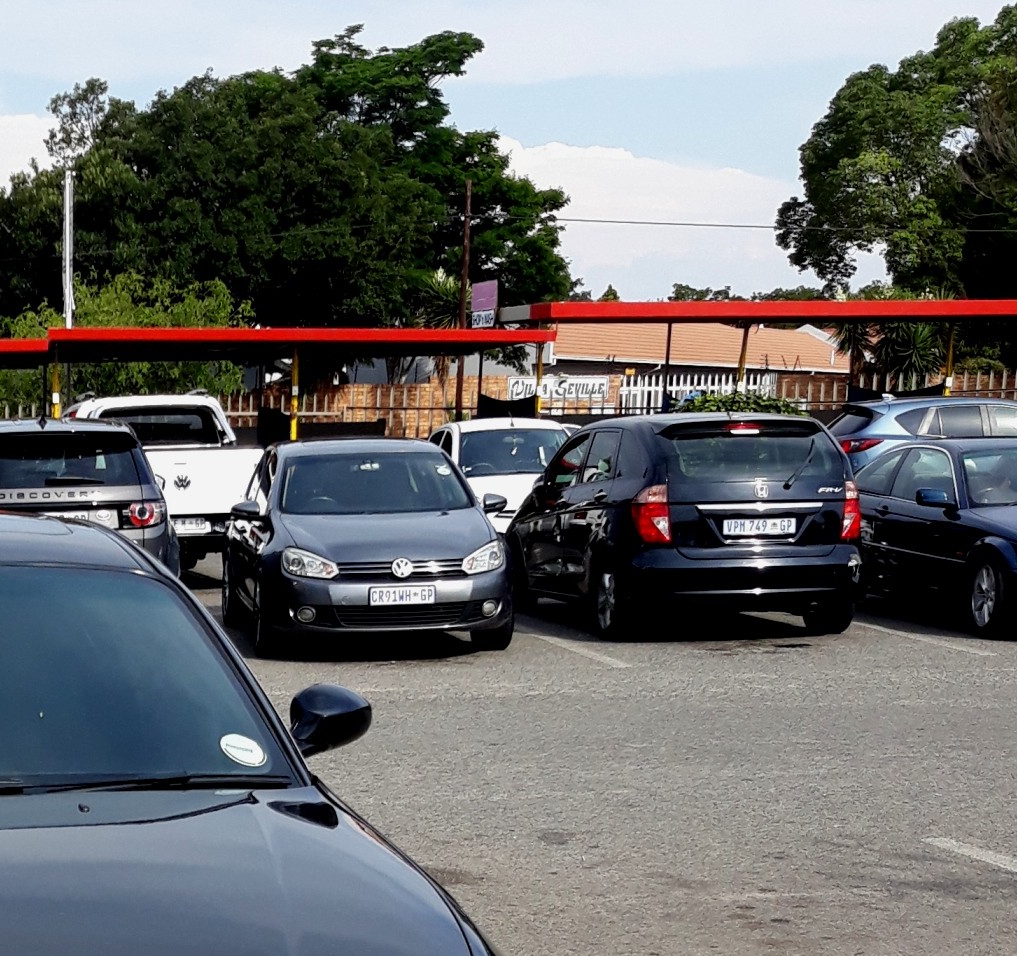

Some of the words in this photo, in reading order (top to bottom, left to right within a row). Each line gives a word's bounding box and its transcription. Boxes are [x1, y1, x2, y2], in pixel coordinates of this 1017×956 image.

[554, 379, 605, 396] SEVILLE
[726, 520, 746, 532] VPM
[749, 519, 768, 531] 749
[780, 519, 793, 531] GP
[371, 590, 411, 603] CR91WH
[420, 588, 433, 601] GP
